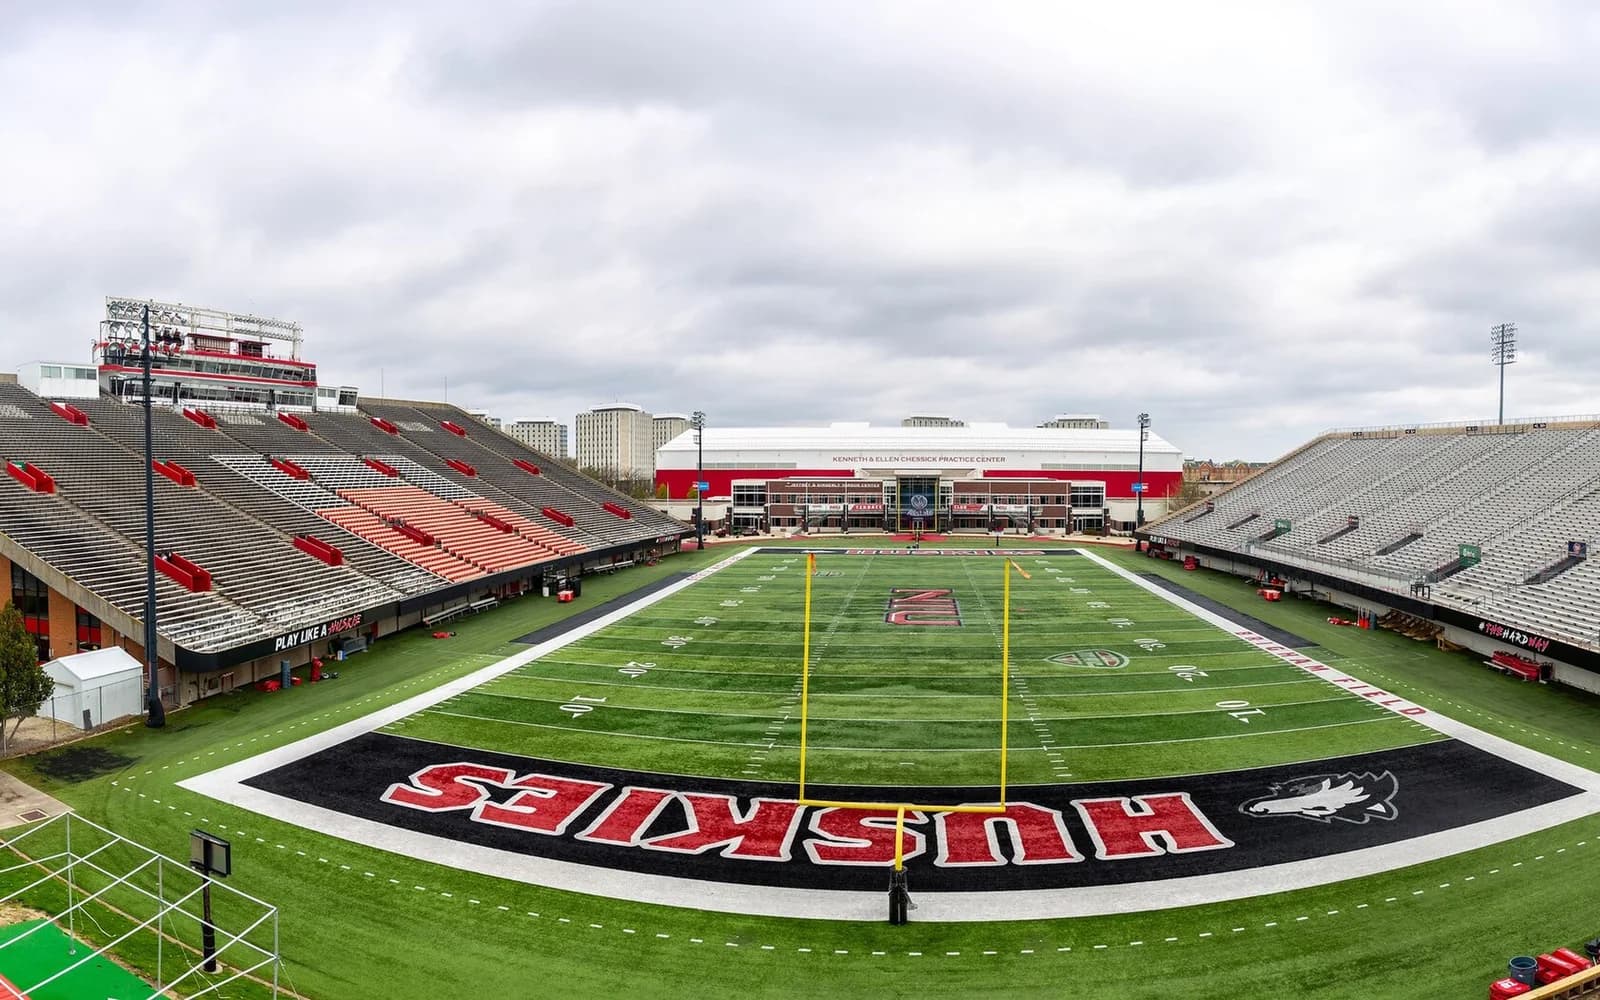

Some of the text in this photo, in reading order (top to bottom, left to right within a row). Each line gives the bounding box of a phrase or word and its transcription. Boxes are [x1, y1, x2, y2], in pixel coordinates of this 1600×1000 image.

[275, 632, 299, 651] PLAY
[300, 626, 320, 643] LIKE
[320, 624, 327, 637] A
[618, 661, 656, 675] 20
[1168, 665, 1208, 679] 20
[1236, 631, 1427, 716] BRIGHAM FIELD
[559, 695, 607, 714] 10
[1216, 700, 1266, 718] 10
[380, 762, 1236, 868] HUSKIES
